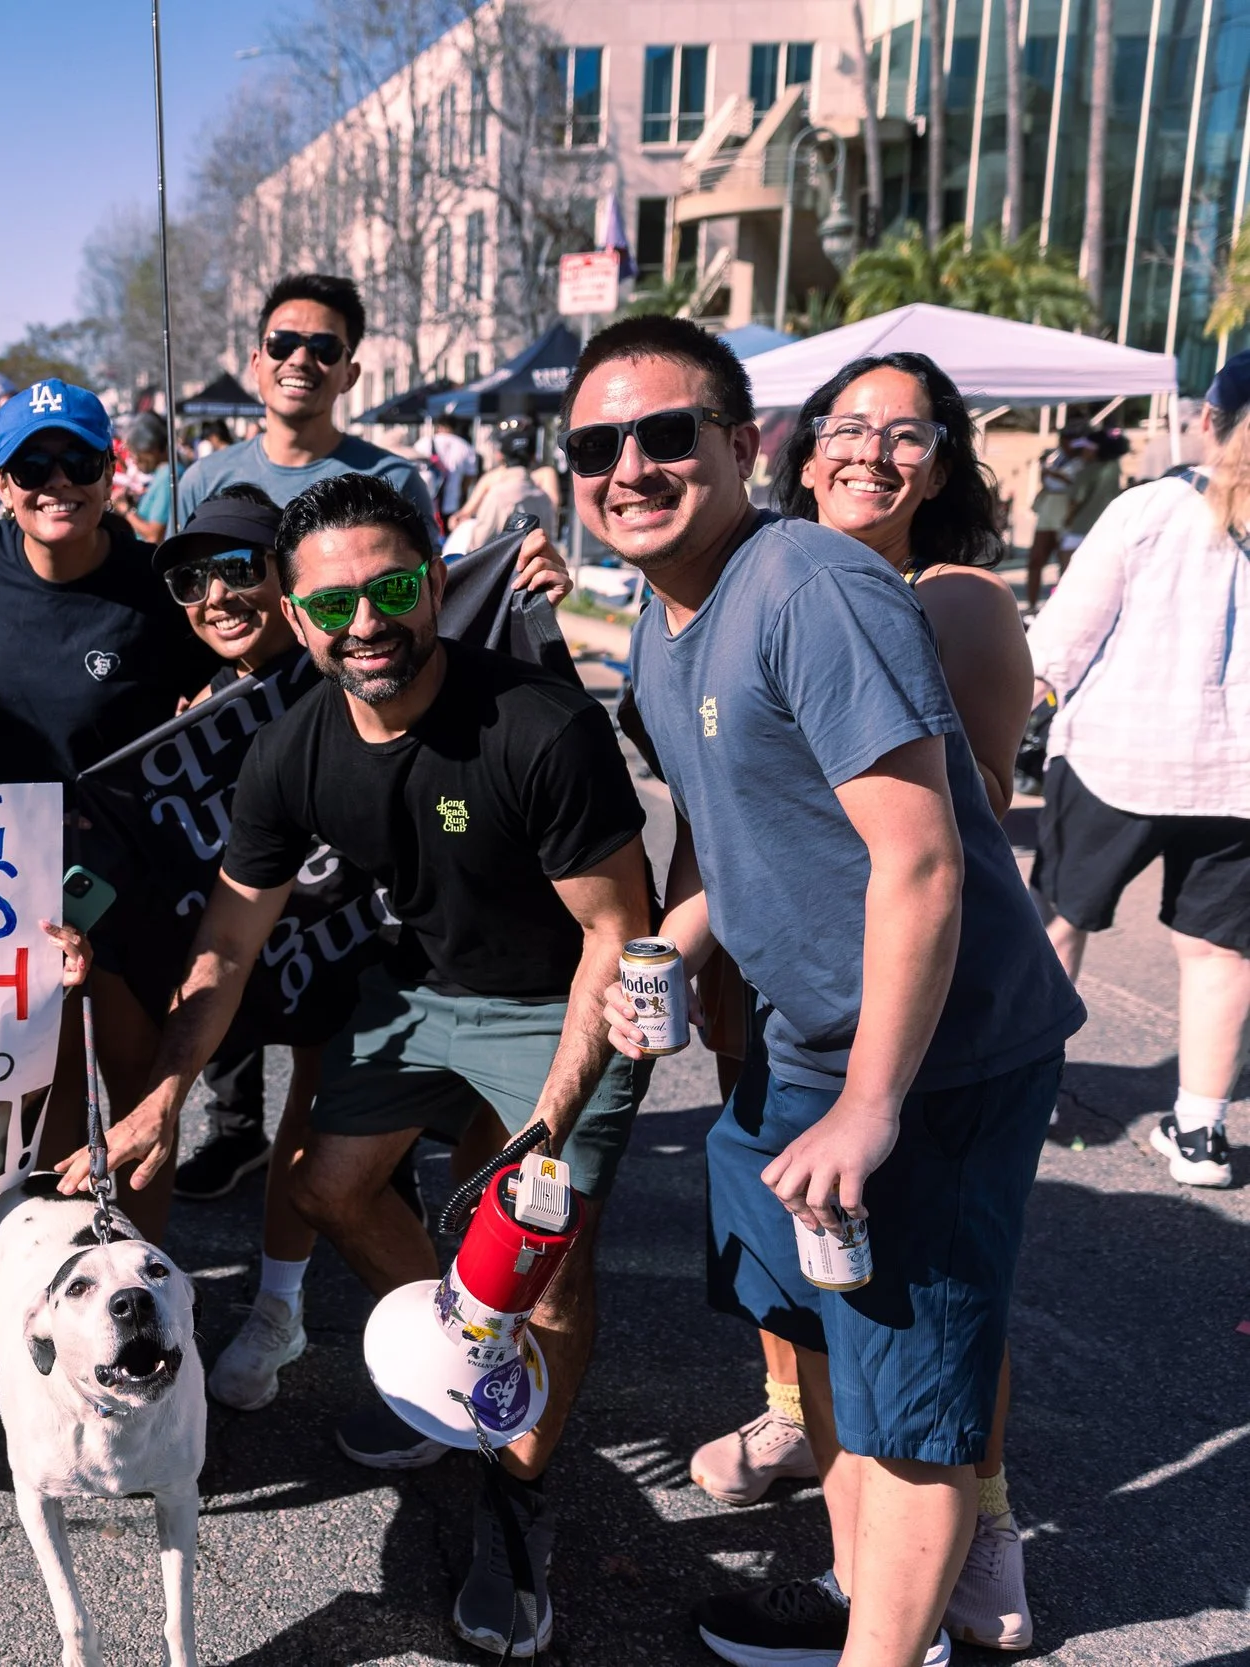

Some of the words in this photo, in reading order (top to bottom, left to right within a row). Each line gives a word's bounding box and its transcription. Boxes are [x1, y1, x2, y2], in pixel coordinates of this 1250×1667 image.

[29, 383, 62, 413] LA
[440, 796, 465, 809] Long
[436, 805, 470, 819] Beach
[445, 814, 467, 827] Run
[443, 823, 466, 832] Club
